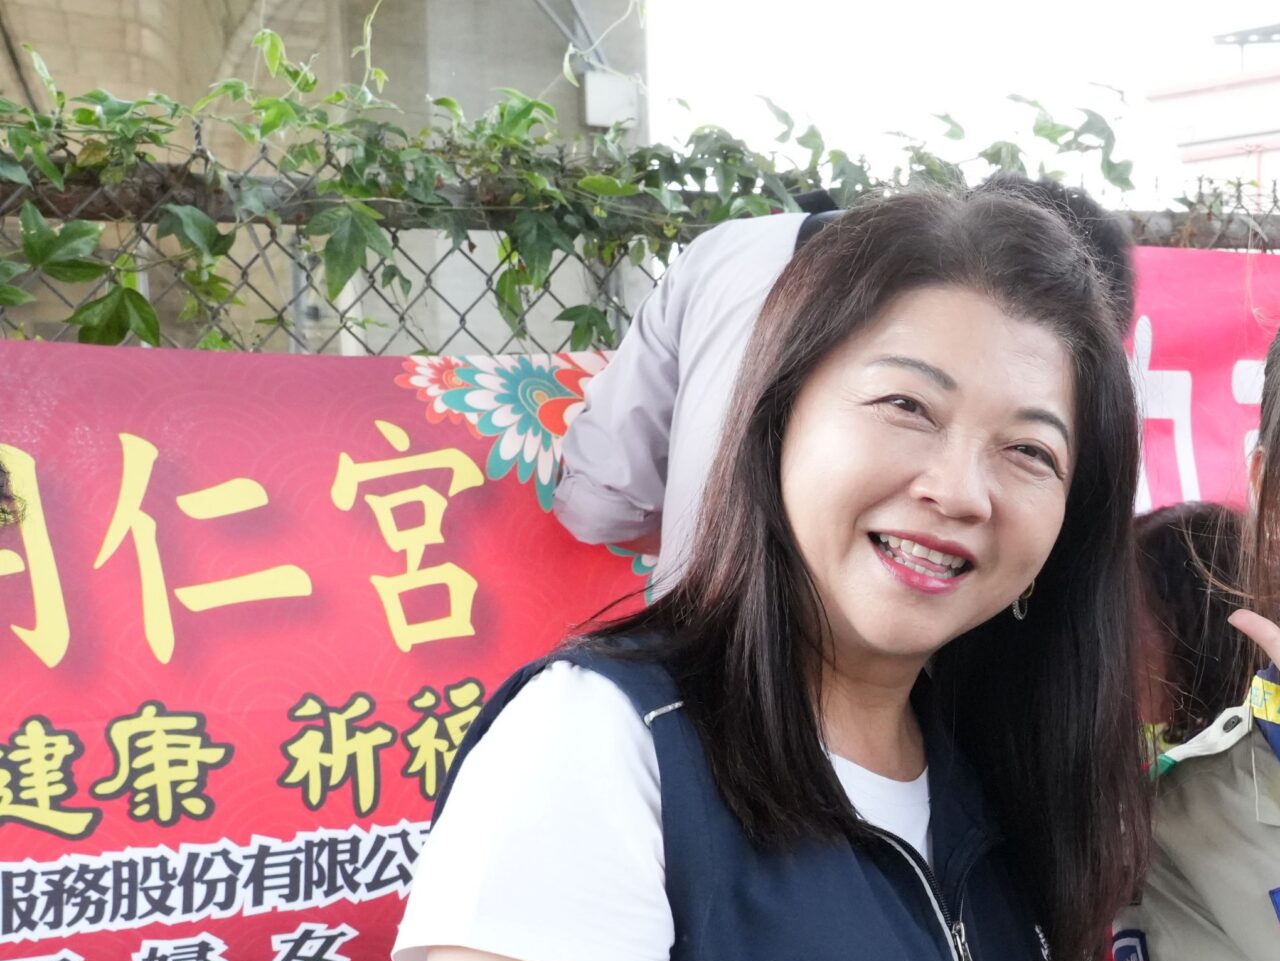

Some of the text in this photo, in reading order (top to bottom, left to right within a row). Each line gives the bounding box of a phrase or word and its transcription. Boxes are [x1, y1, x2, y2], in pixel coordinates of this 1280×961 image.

[0, 828, 431, 935] 服務股份有限公
